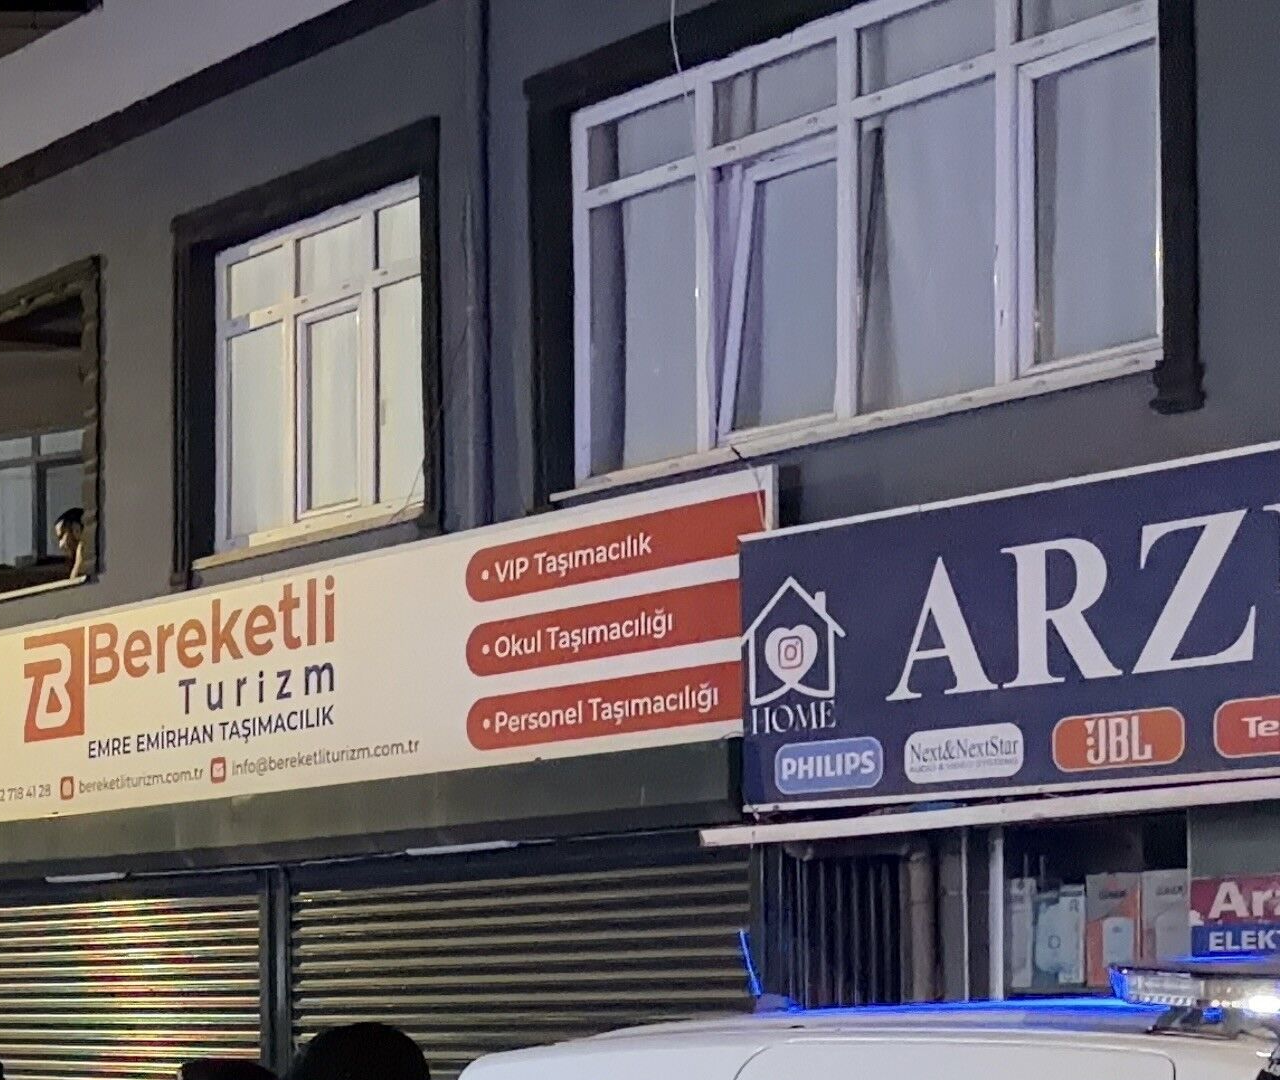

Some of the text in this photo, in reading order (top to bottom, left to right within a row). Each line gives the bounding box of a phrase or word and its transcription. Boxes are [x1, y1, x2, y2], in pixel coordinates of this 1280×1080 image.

[495, 532, 652, 582] VIP Taşımacılık
[885, 503, 1280, 701] ARZ
[88, 574, 335, 685] Bereketli
[494, 608, 673, 658] Okul Taşımacılığı
[178, 660, 335, 715] Turizm
[494, 682, 719, 733] Personel Taşımacılığı
[88, 704, 335, 759] EMRE EMİRHAN TAŞIMACILIK
[751, 700, 837, 735] HOME
[1085, 715, 1152, 765] JBL
[781, 750, 876, 780] PHILIPS
